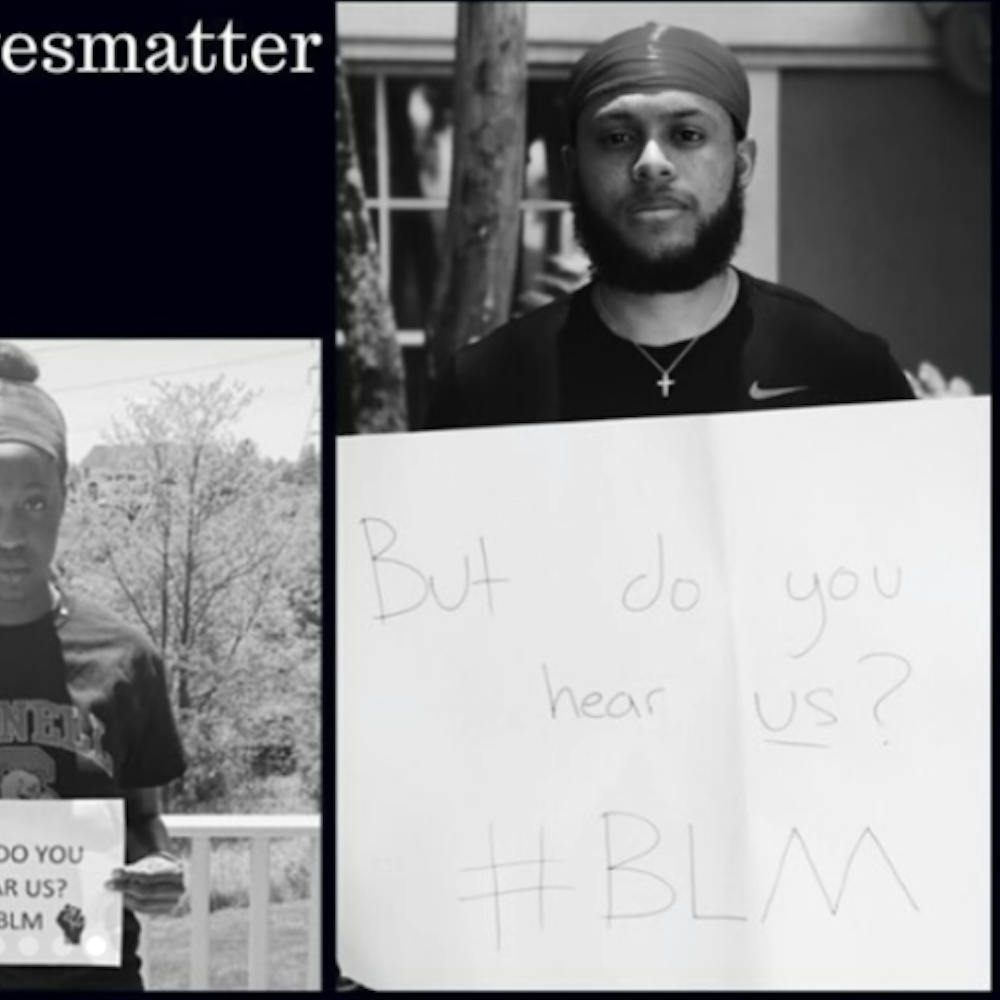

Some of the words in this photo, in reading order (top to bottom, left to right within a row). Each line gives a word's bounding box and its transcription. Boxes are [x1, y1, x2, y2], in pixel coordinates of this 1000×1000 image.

[360, 517, 509, 625] But
[621, 533, 703, 613] do
[786, 563, 902, 659] you
[541, 662, 666, 720] hear
[35, 845, 85, 864] YOU
[458, 810, 921, 951] #BLM
[26, 878, 68, 898] US?
